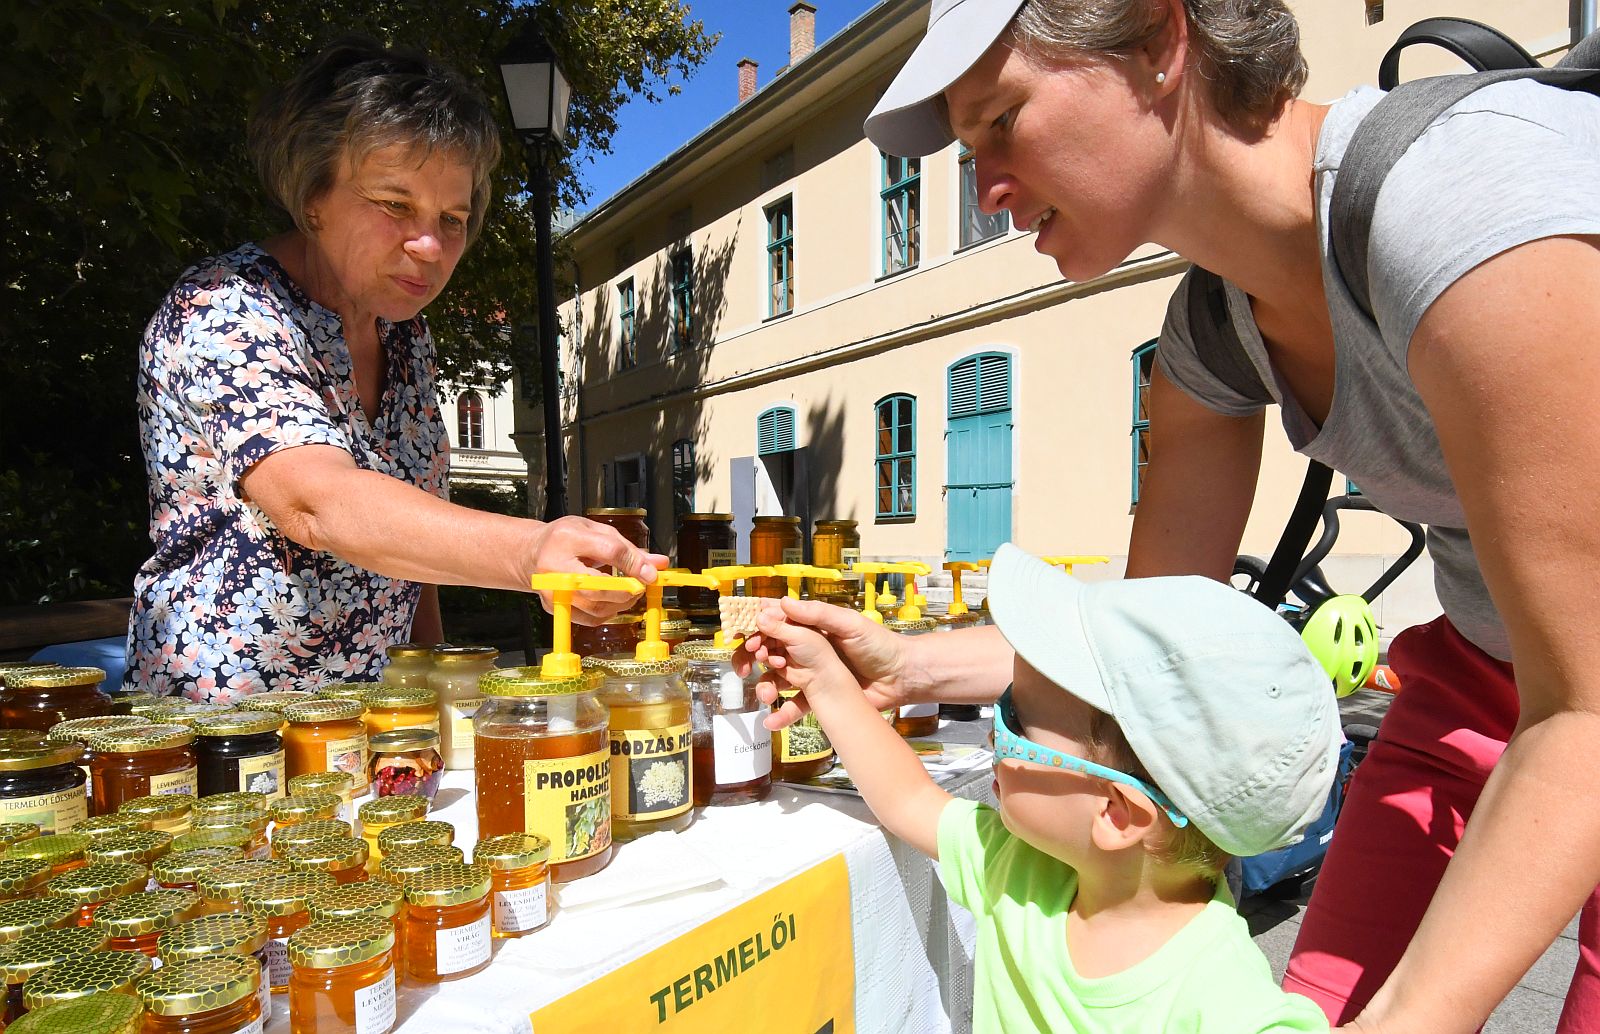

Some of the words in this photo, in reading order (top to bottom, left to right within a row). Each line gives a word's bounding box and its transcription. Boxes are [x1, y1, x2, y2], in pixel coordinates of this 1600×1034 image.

[610, 735, 675, 756] BODZÁS
[4, 796, 48, 811] TERMELŐI
[650, 912, 796, 1024] TERMELŐI
